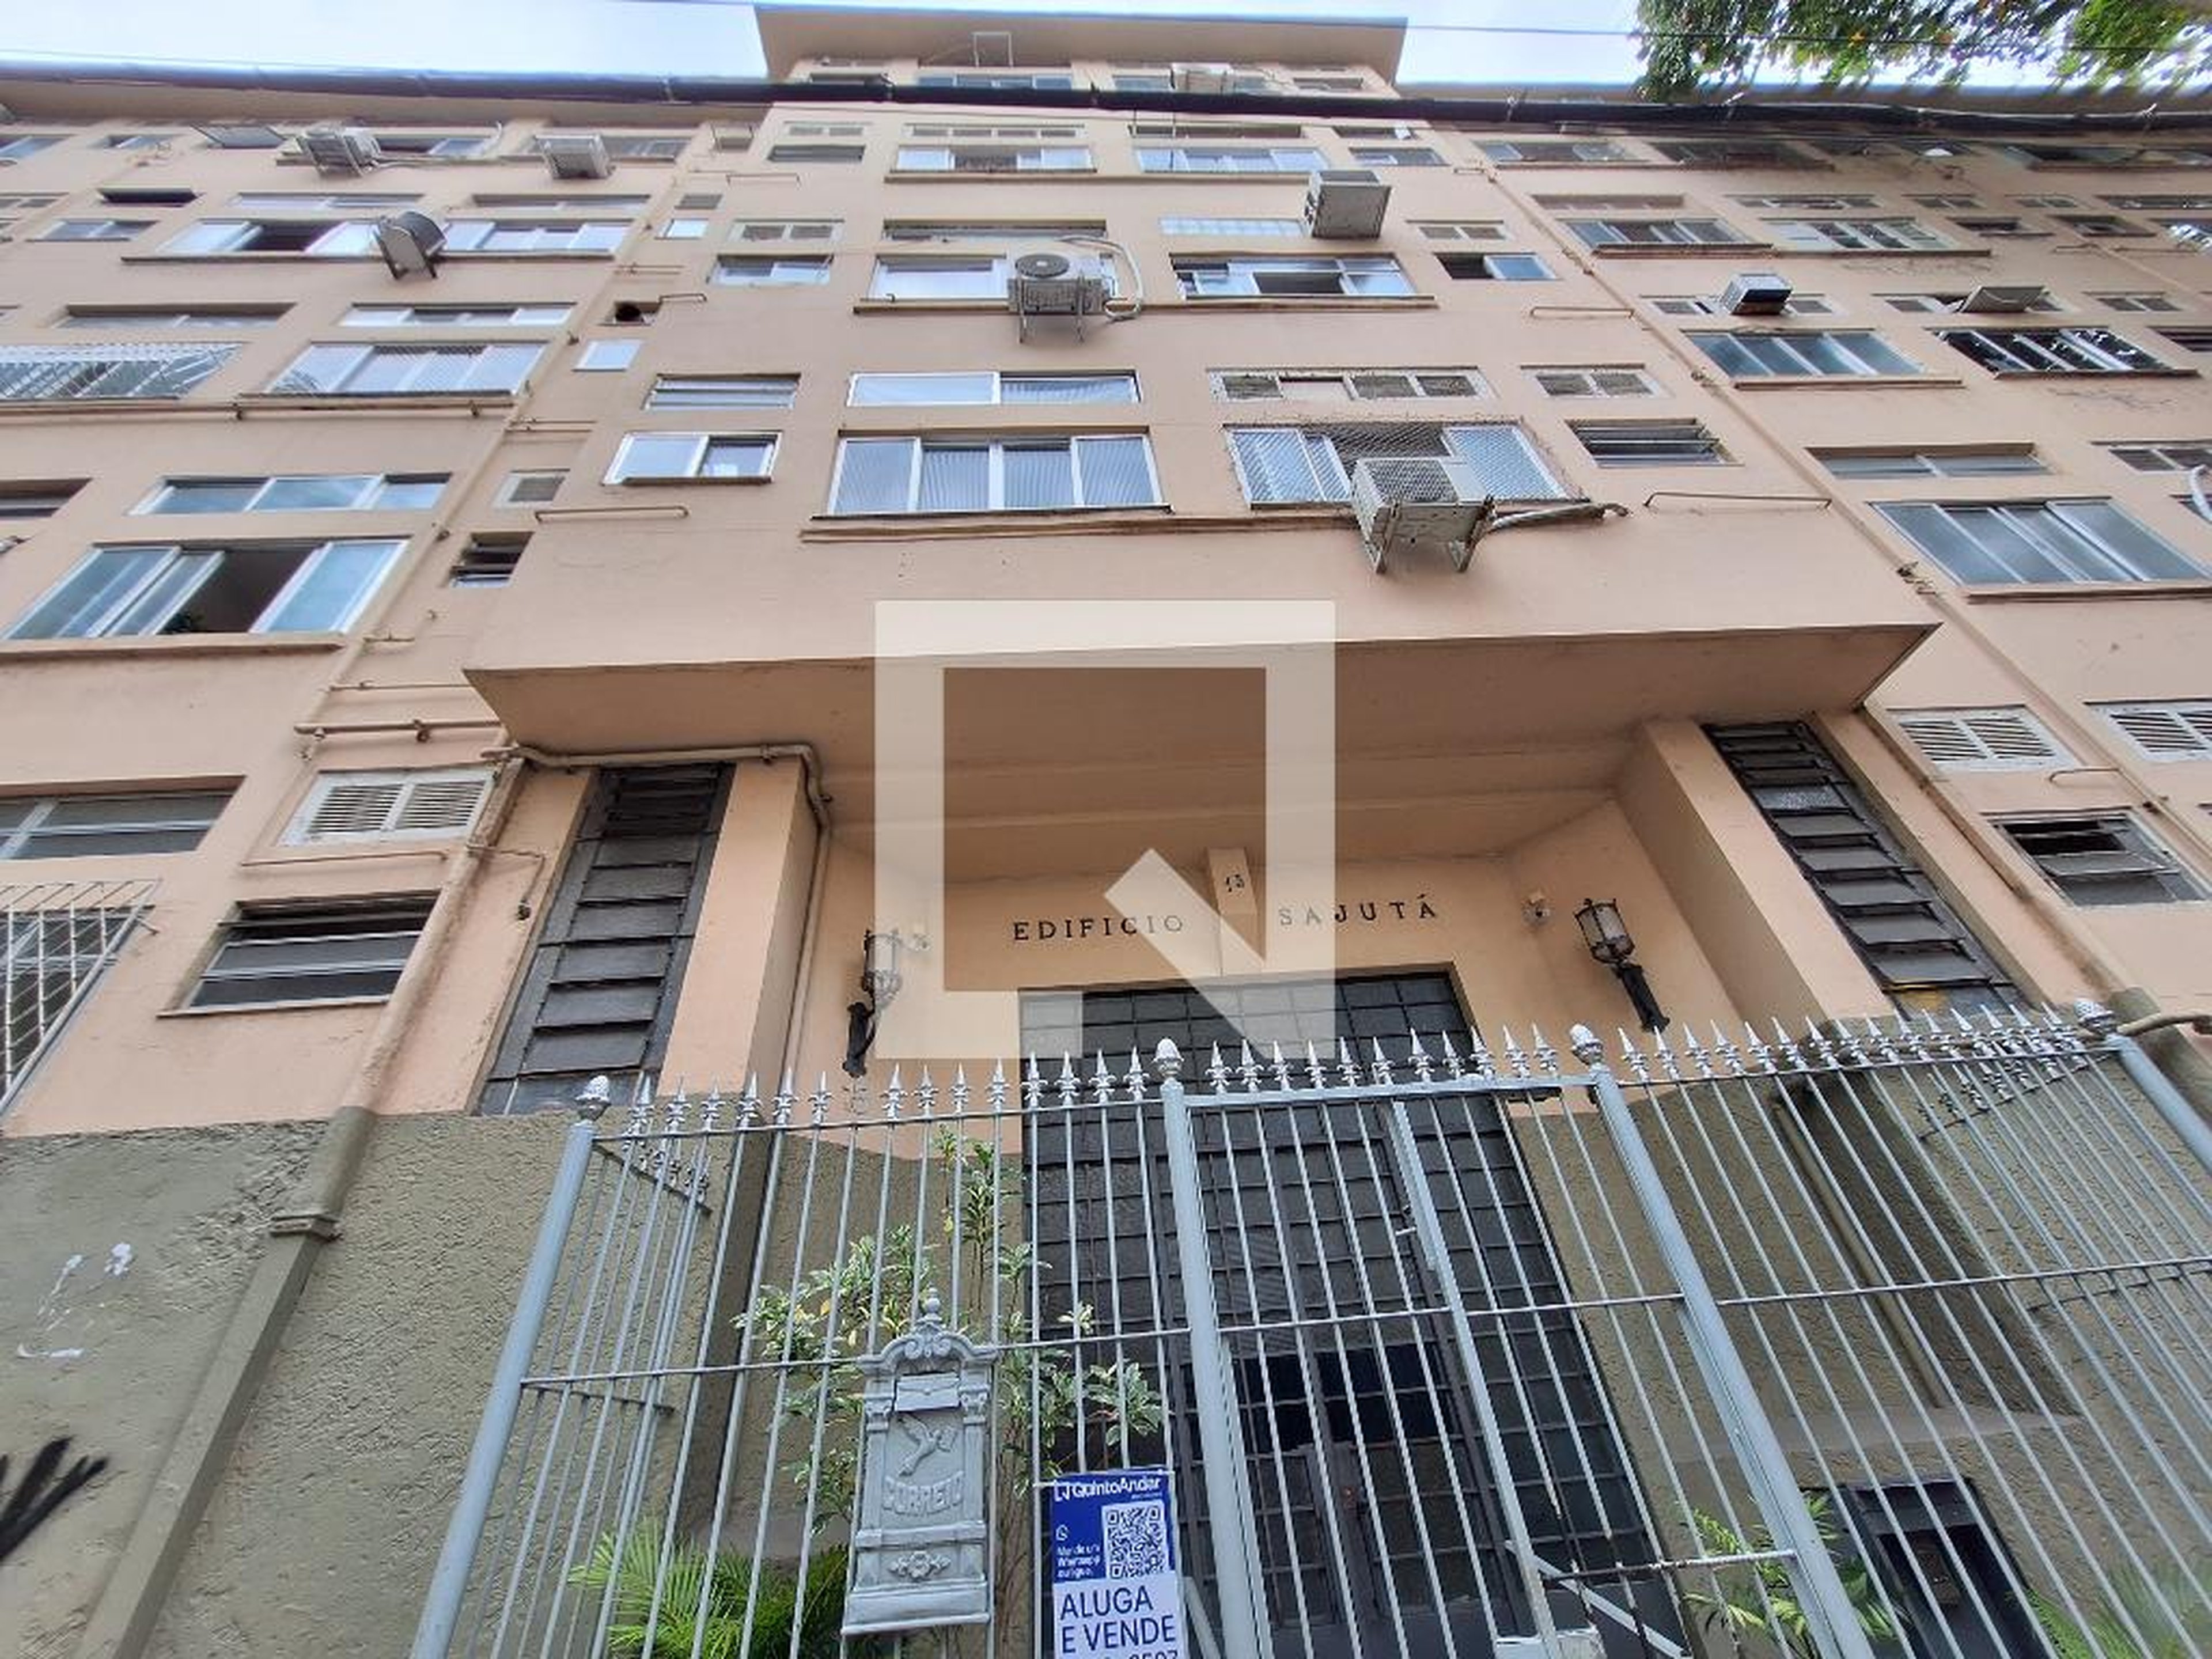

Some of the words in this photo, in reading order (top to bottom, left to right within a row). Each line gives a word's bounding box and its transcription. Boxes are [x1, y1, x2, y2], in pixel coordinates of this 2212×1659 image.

[1013, 915, 1183, 941] EDIFICIO
[1278, 893, 1435, 926] SAJUTÁ
[1059, 1585, 1154, 1620] ALUGA
[1062, 1626, 1076, 1653] E
[1084, 1615, 1176, 1651] VENDE
